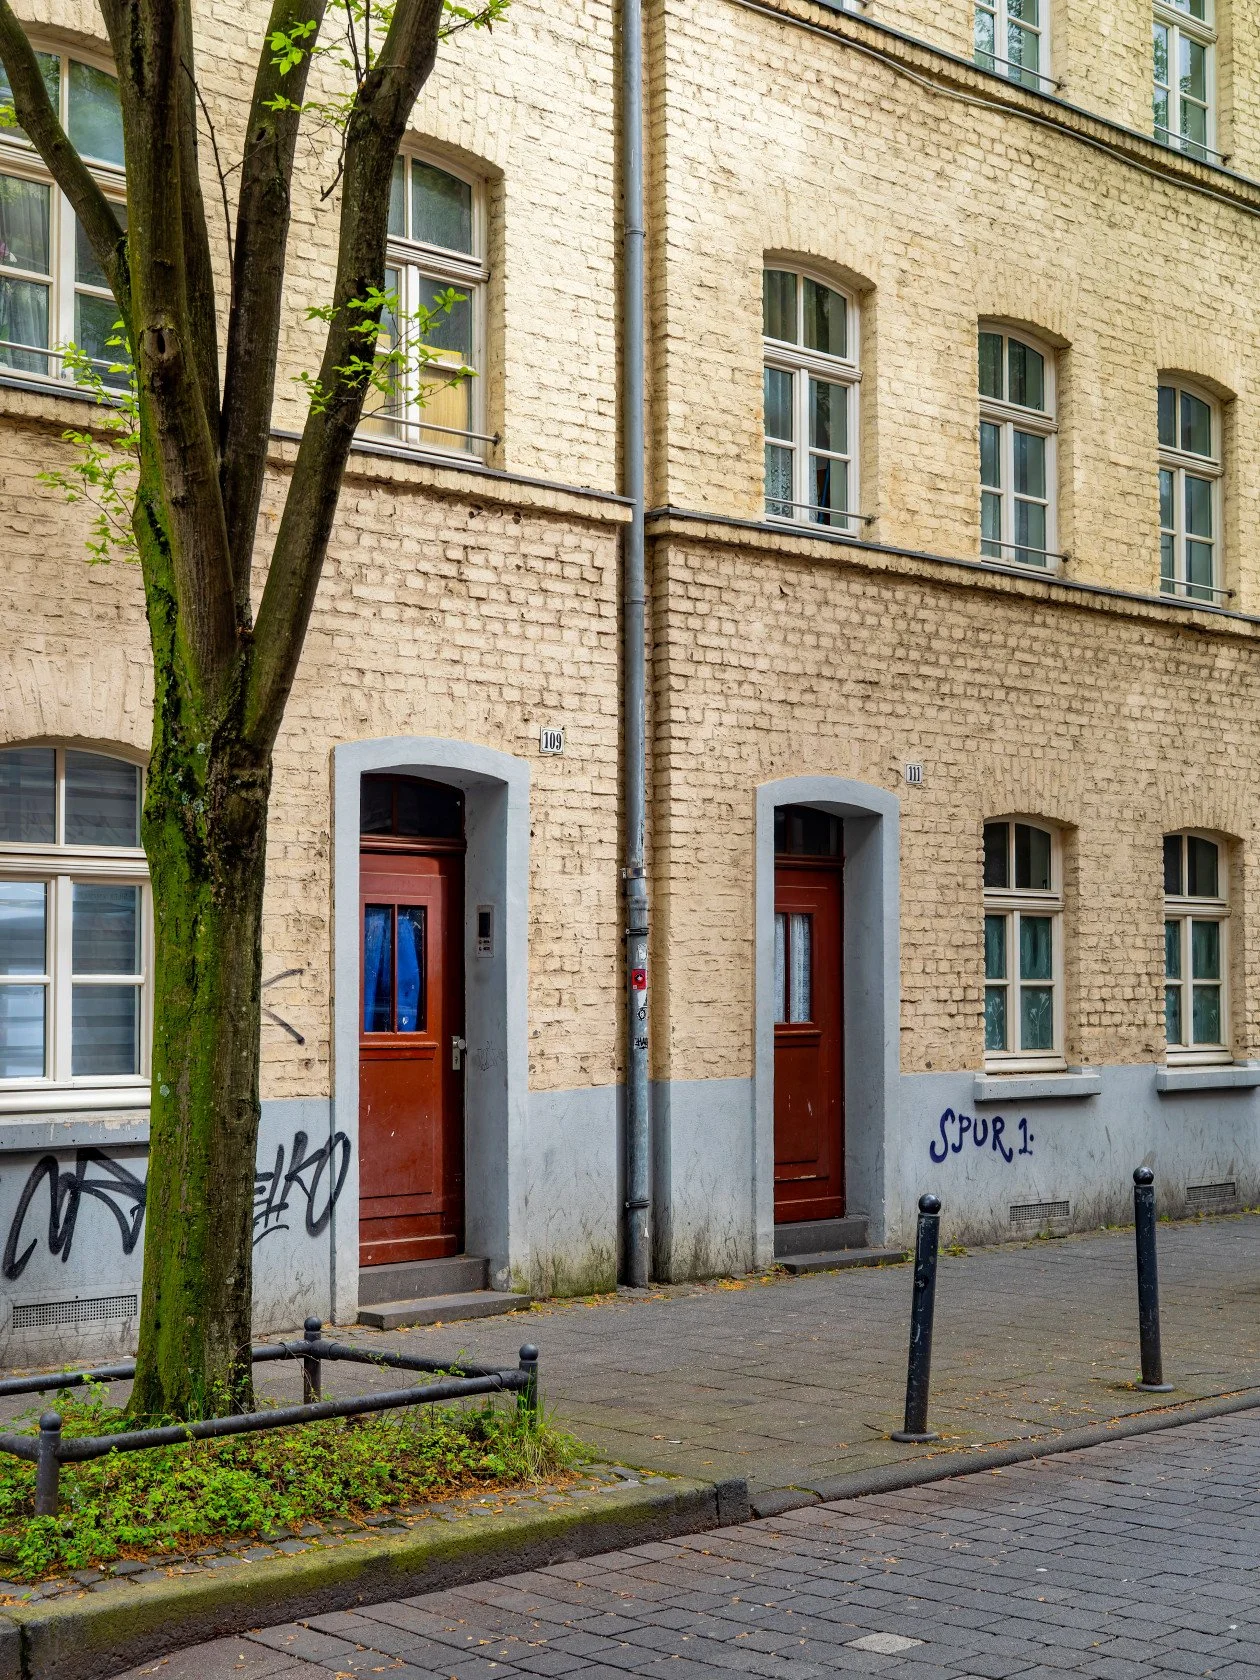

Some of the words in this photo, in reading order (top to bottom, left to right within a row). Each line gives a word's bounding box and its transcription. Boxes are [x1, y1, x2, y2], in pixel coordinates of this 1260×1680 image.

[543, 731, 562, 750] 109
[909, 766, 920, 781] 111
[930, 1108, 1013, 1163] SPUR
